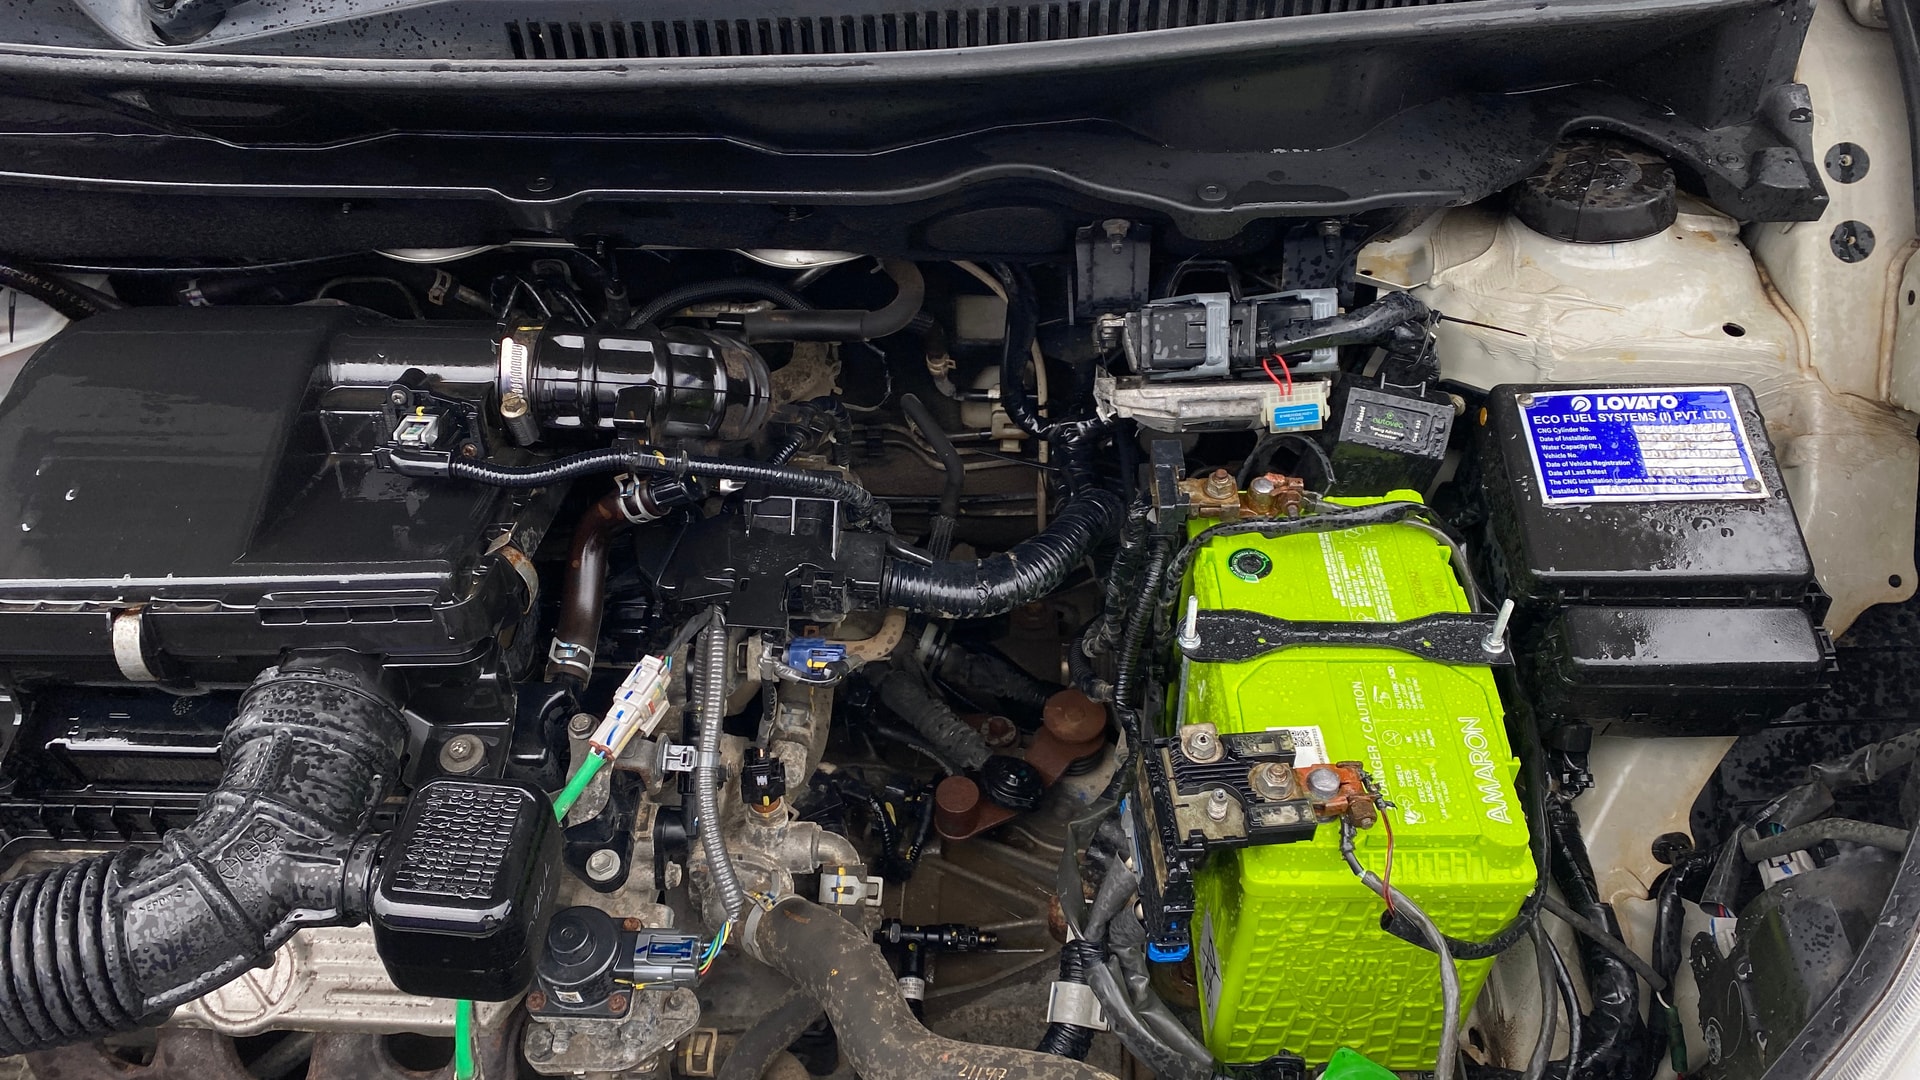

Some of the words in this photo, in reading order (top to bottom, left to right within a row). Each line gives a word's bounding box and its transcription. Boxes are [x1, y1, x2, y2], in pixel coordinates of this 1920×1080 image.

[1597, 395, 1678, 411] LOVATO
[1533, 415, 1560, 424] ECO
[1563, 414, 1596, 423] FUEL
[1598, 412, 1656, 422] SYSTEMS
[1659, 411, 1671, 424] (I)
[1674, 410, 1701, 421] PVT.
[1703, 410, 1731, 420] LTD.
[1552, 426, 1579, 434] Cylinder
[1560, 443, 1588, 452] Capacity
[1593, 459, 1631, 468] Registration
[1614, 477, 1642, 485] complies
[1578, 487, 1590, 495] by:
[1352, 681, 1374, 733] CAUTION
[1367, 744, 1389, 797] DANGER
[1394, 764, 1406, 788] SHIELD
[1404, 770, 1414, 787] EYES
[1457, 716, 1513, 825] AMARON
[1314, 976, 1398, 992] FRAME
